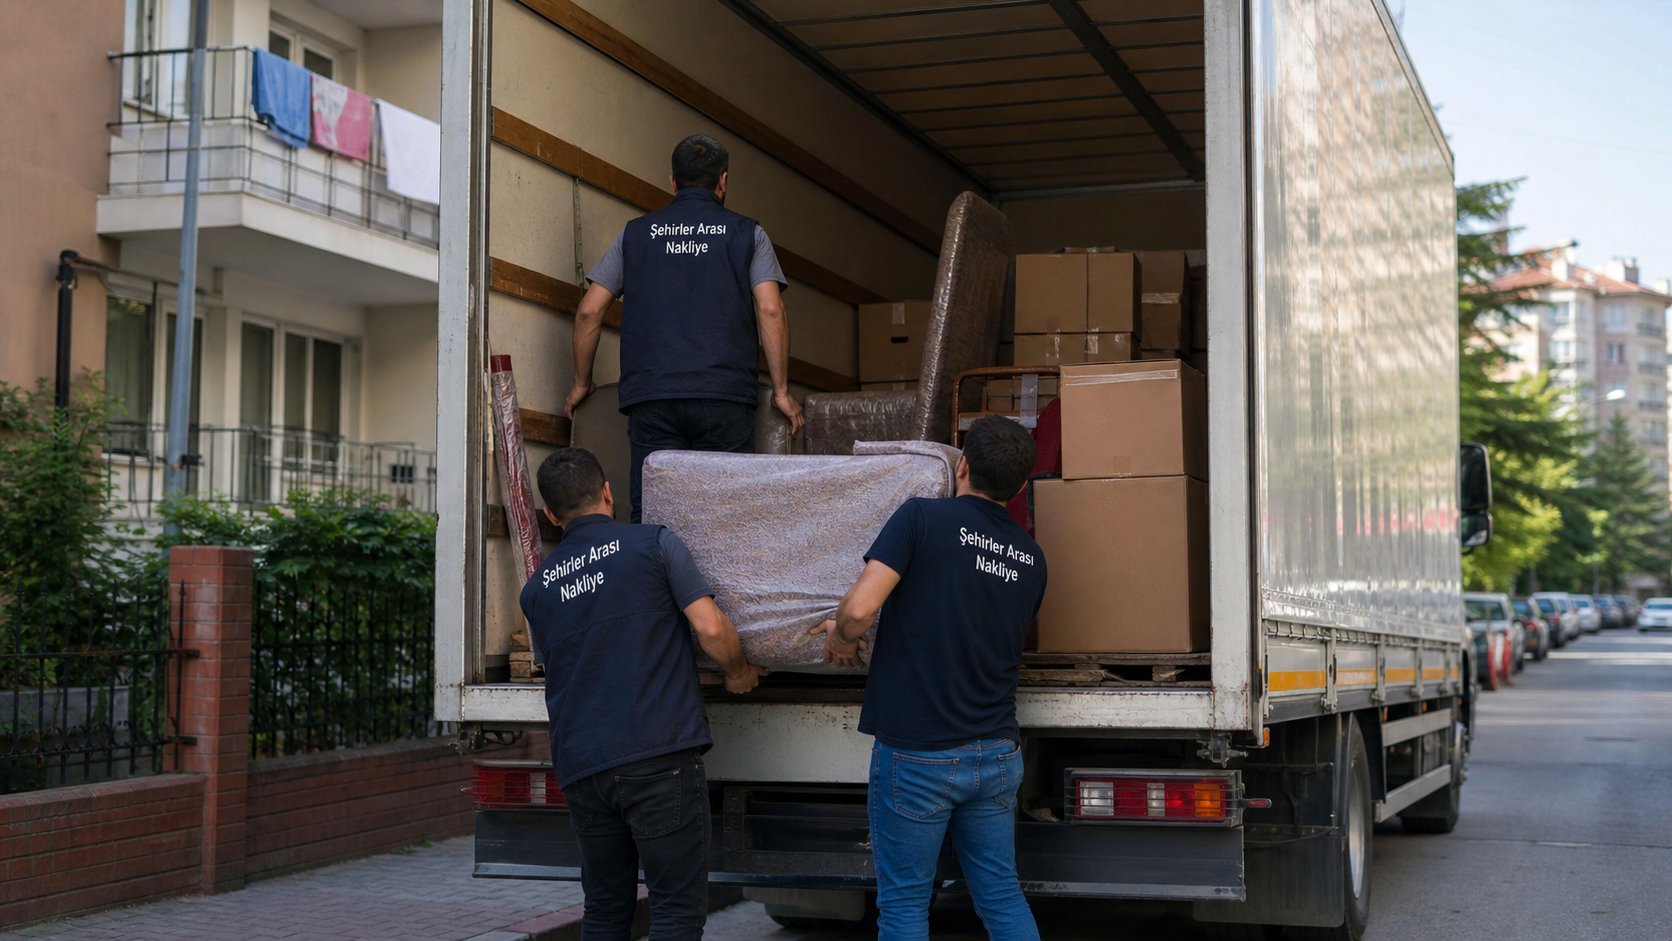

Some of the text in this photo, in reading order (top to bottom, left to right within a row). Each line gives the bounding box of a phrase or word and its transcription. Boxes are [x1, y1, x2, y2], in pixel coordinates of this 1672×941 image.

[650, 222, 727, 239] Şehirler Arası
[666, 240, 709, 257] Nakliye
[959, 526, 1034, 567] Şehirler Arası
[542, 539, 620, 589] Şehirler Arası
[976, 554, 1019, 582] Nakliye
[560, 571, 605, 603] Nakliye
